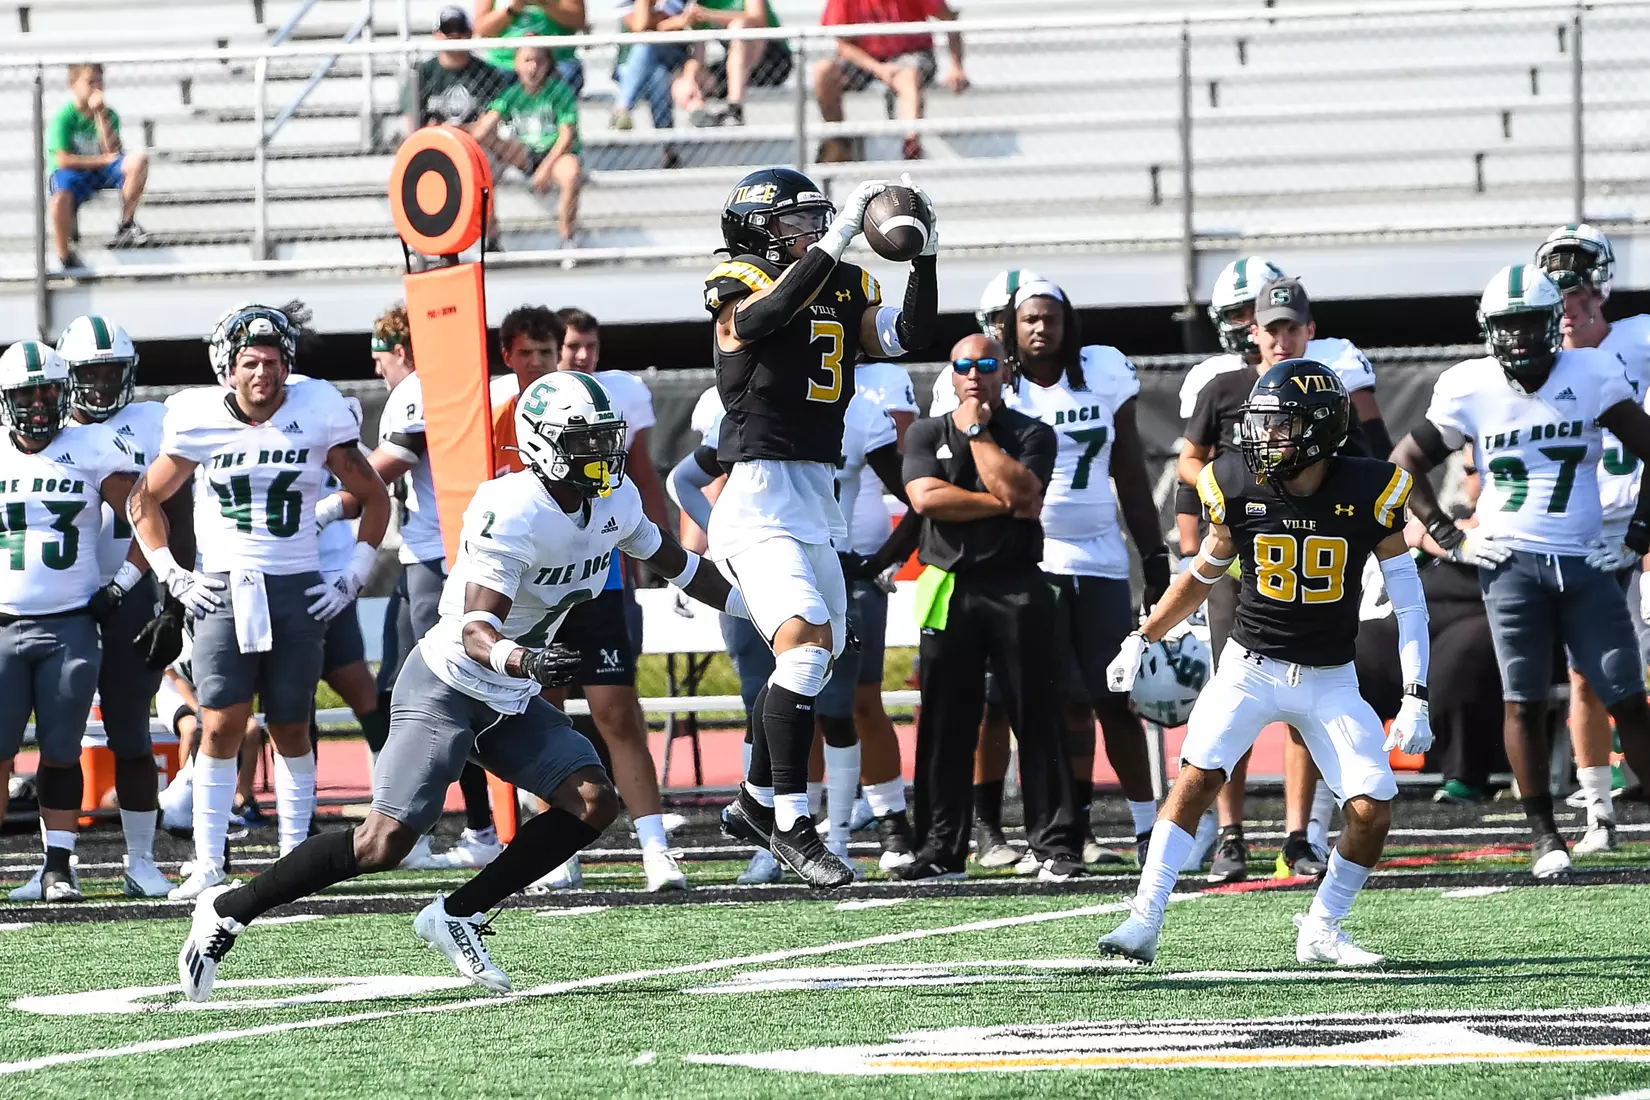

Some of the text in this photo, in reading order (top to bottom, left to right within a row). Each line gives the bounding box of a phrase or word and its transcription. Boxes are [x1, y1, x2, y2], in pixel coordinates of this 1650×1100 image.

[809, 305, 837, 318] VILLE
[1270, 288, 1291, 306] S
[806, 319, 845, 403] 3
[523, 383, 558, 416] S
[1291, 375, 1346, 396] VILL
[1055, 405, 1100, 425] ROCK
[1485, 420, 1583, 450] THE ROCK
[212, 448, 310, 469] THE ROCK
[1063, 426, 1108, 490] 7
[0, 477, 84, 494] HE ROCK
[1488, 444, 1588, 513] 97
[209, 470, 302, 538] 46
[0, 499, 88, 571] 43
[480, 510, 496, 539] 2
[1283, 520, 1316, 531] VILLE
[533, 550, 611, 586] THE ROC
[1254, 533, 1348, 604] 89
